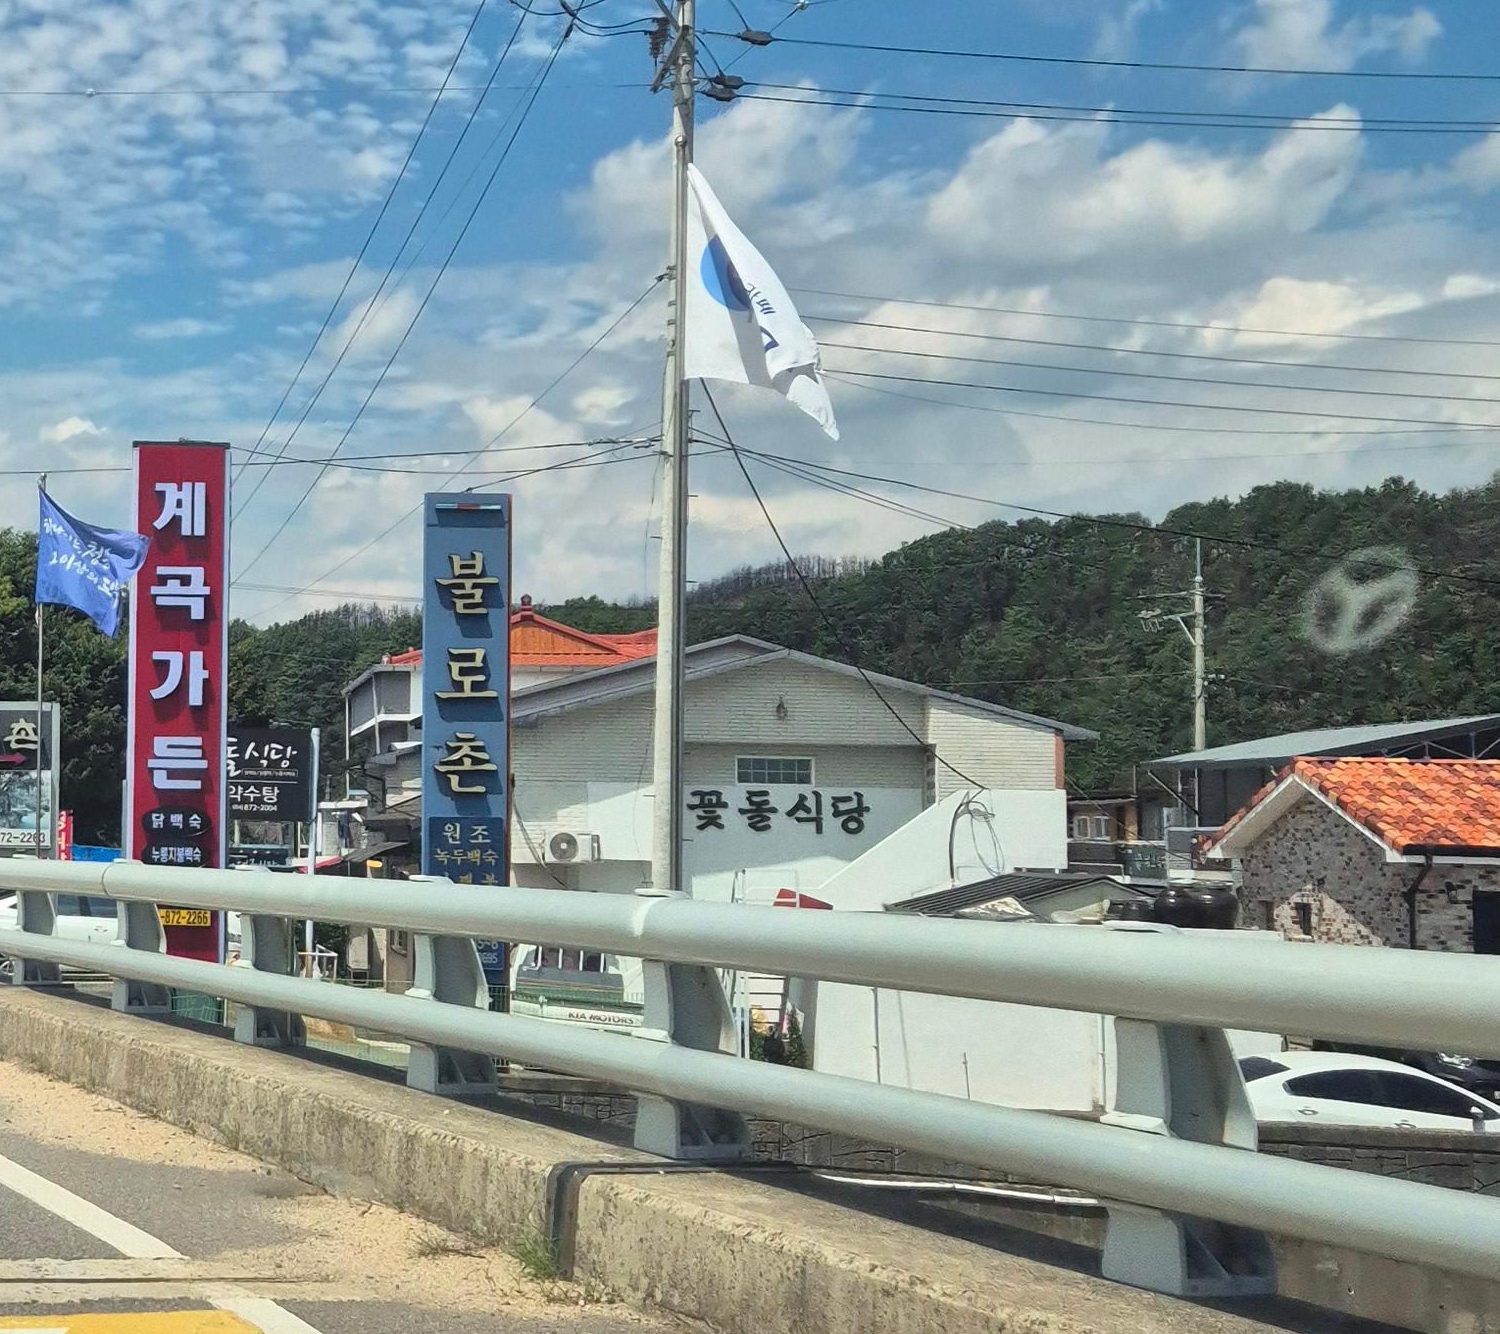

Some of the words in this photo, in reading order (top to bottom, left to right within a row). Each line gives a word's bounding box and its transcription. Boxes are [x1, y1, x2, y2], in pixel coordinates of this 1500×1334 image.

[148, 482, 211, 789] 계곡가든
[435, 551, 499, 793] 불로촌
[229, 785, 280, 803] 약수탕
[151, 813, 202, 829] 닭백숙
[686, 790, 871, 835] 꽃돌식당
[443, 822, 492, 844] 원조
[434, 848, 500, 866] 녹두백숙
[568, 1012, 587, 1020] KIA
[589, 1014, 634, 1025] MOTORS
